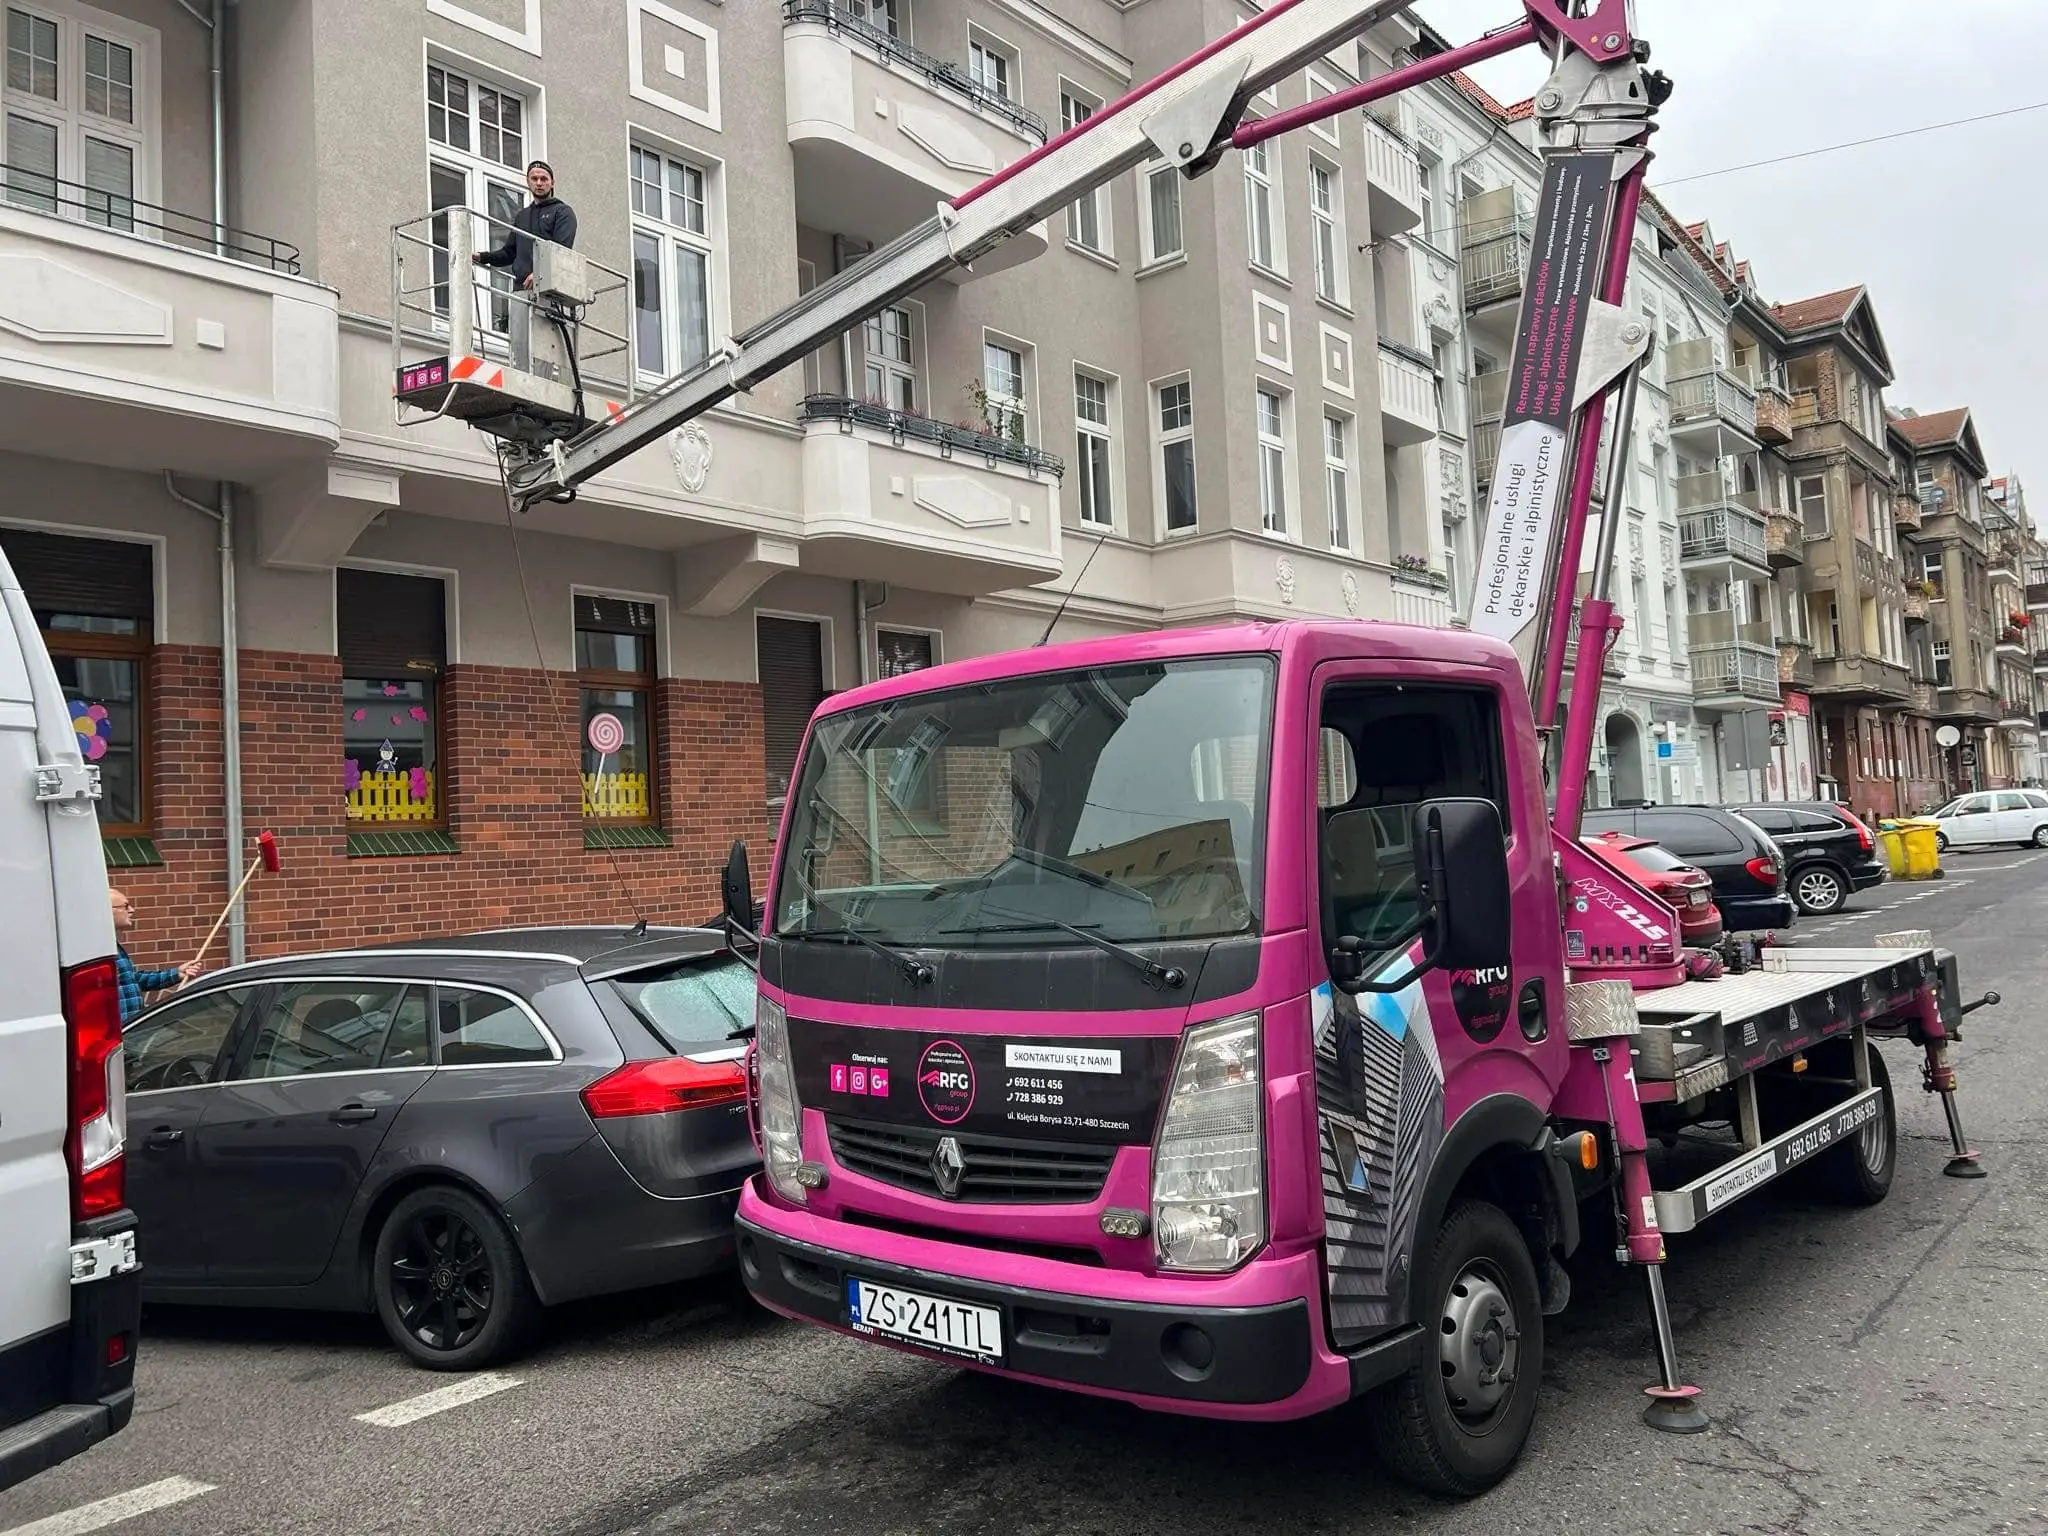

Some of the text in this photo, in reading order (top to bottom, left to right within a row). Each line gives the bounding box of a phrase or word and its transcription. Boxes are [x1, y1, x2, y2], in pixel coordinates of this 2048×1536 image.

[1534, 260, 1551, 305] dachów
[1528, 307, 1545, 355] naprawy
[1539, 306, 1560, 378] alpinistyczne
[1556, 296, 1578, 378] podnośnikowe
[1516, 364, 1535, 414] Remonty
[1532, 380, 1549, 415] Usługi
[1549, 381, 1566, 415] Usługi
[1485, 463, 1526, 614] Profesjonalne usługi
[1508, 546, 1534, 617] dekarskie
[1523, 436, 1552, 533] alpinistyczne
[1013, 1051, 1112, 1067] SKONTAKTUJ SIĘ Z NAMI
[940, 1071, 969, 1090] RFG
[1014, 1077, 1063, 1090] 692 611 456
[1014, 1092, 1064, 1105] 728 386 929
[1007, 1112, 1016, 1120] ul.
[1017, 1112, 1038, 1123] Księcia
[1039, 1114, 1062, 1125] Borysa
[1099, 1119, 1130, 1130] Szczecin
[1791, 1123, 1832, 1161] 692 611 456
[1712, 1173, 1745, 1202] SKONTAKTUJ
[1745, 1170, 1754, 1183] SIĘ
[1758, 1158, 1772, 1175] NAMI
[851, 1304, 861, 1317] PL
[864, 1286, 897, 1328] ZS
[907, 1297, 994, 1352] 241TL
